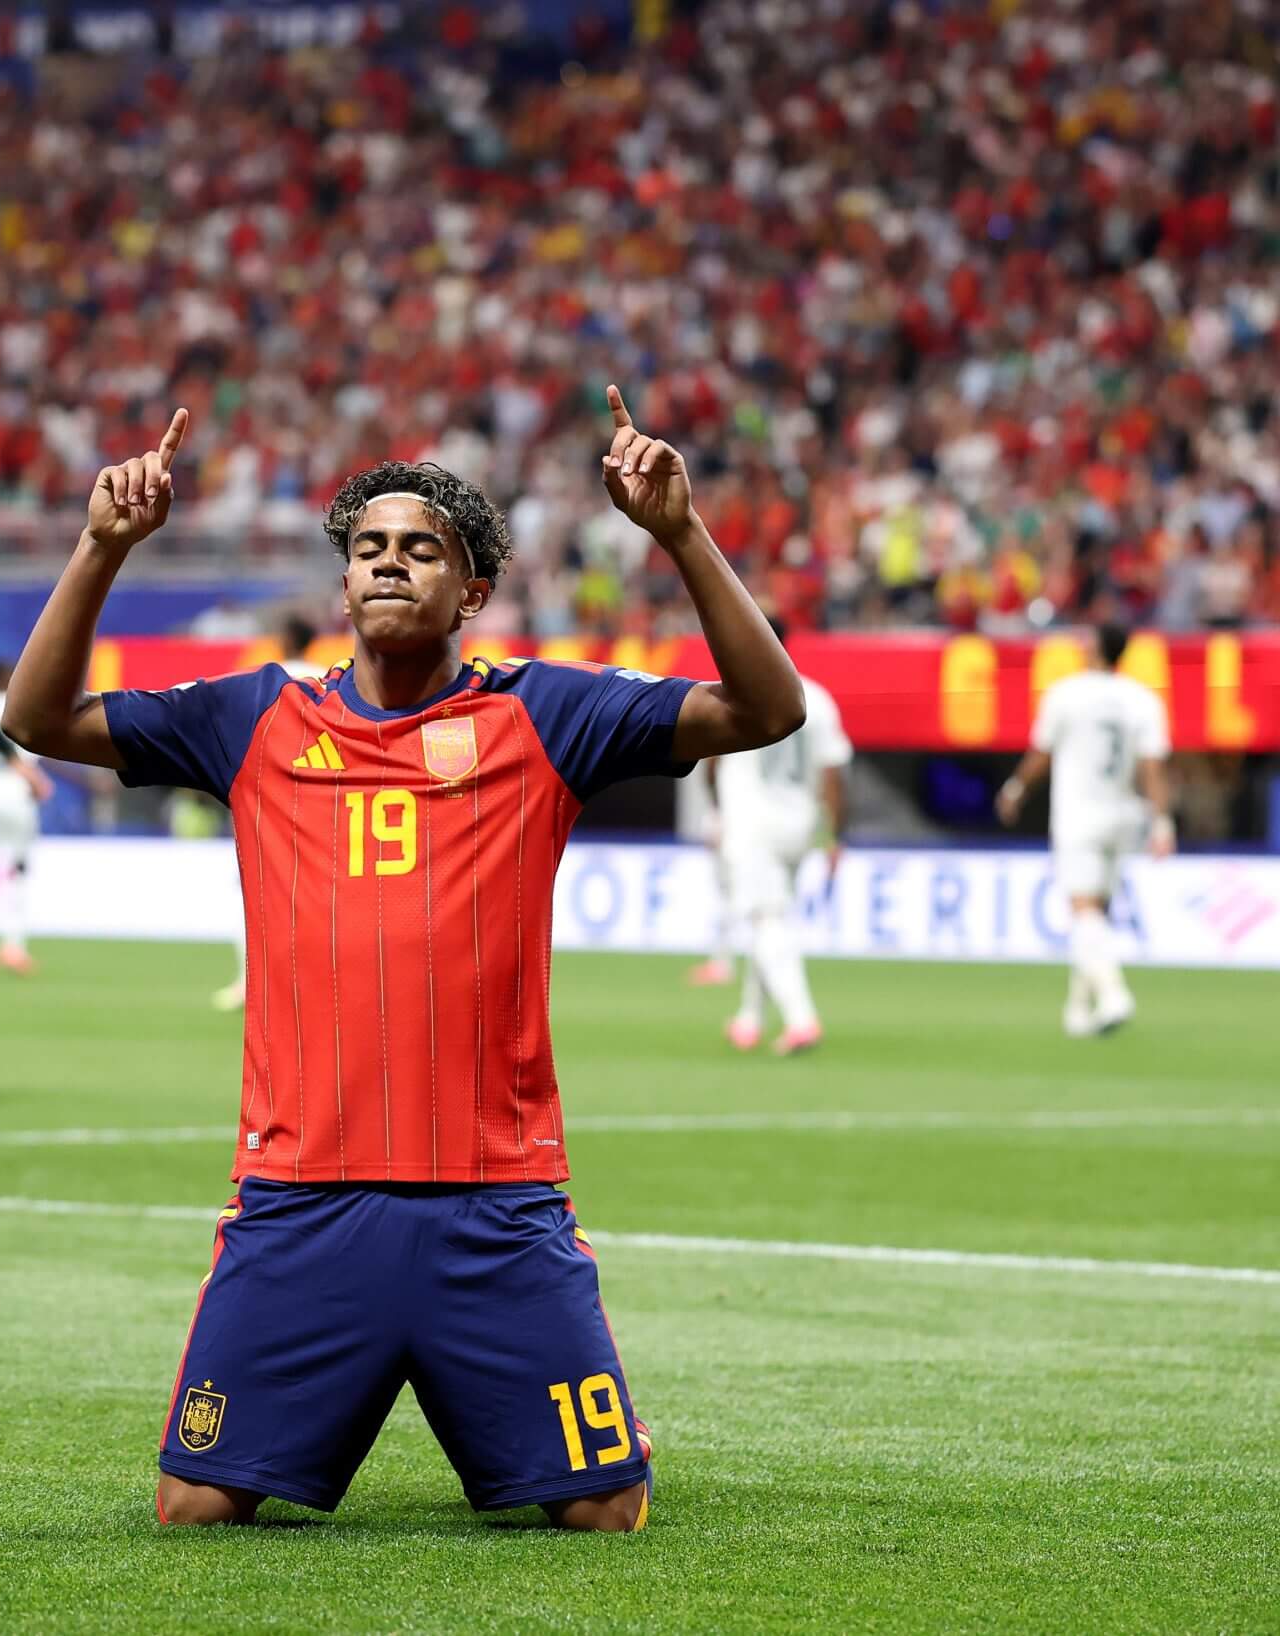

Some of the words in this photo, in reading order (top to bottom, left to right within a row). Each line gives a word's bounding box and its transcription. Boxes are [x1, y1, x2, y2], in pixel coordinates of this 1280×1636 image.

[345, 788, 417, 877] 19
[571, 860, 675, 938] OF
[548, 1372, 632, 1472] 19
